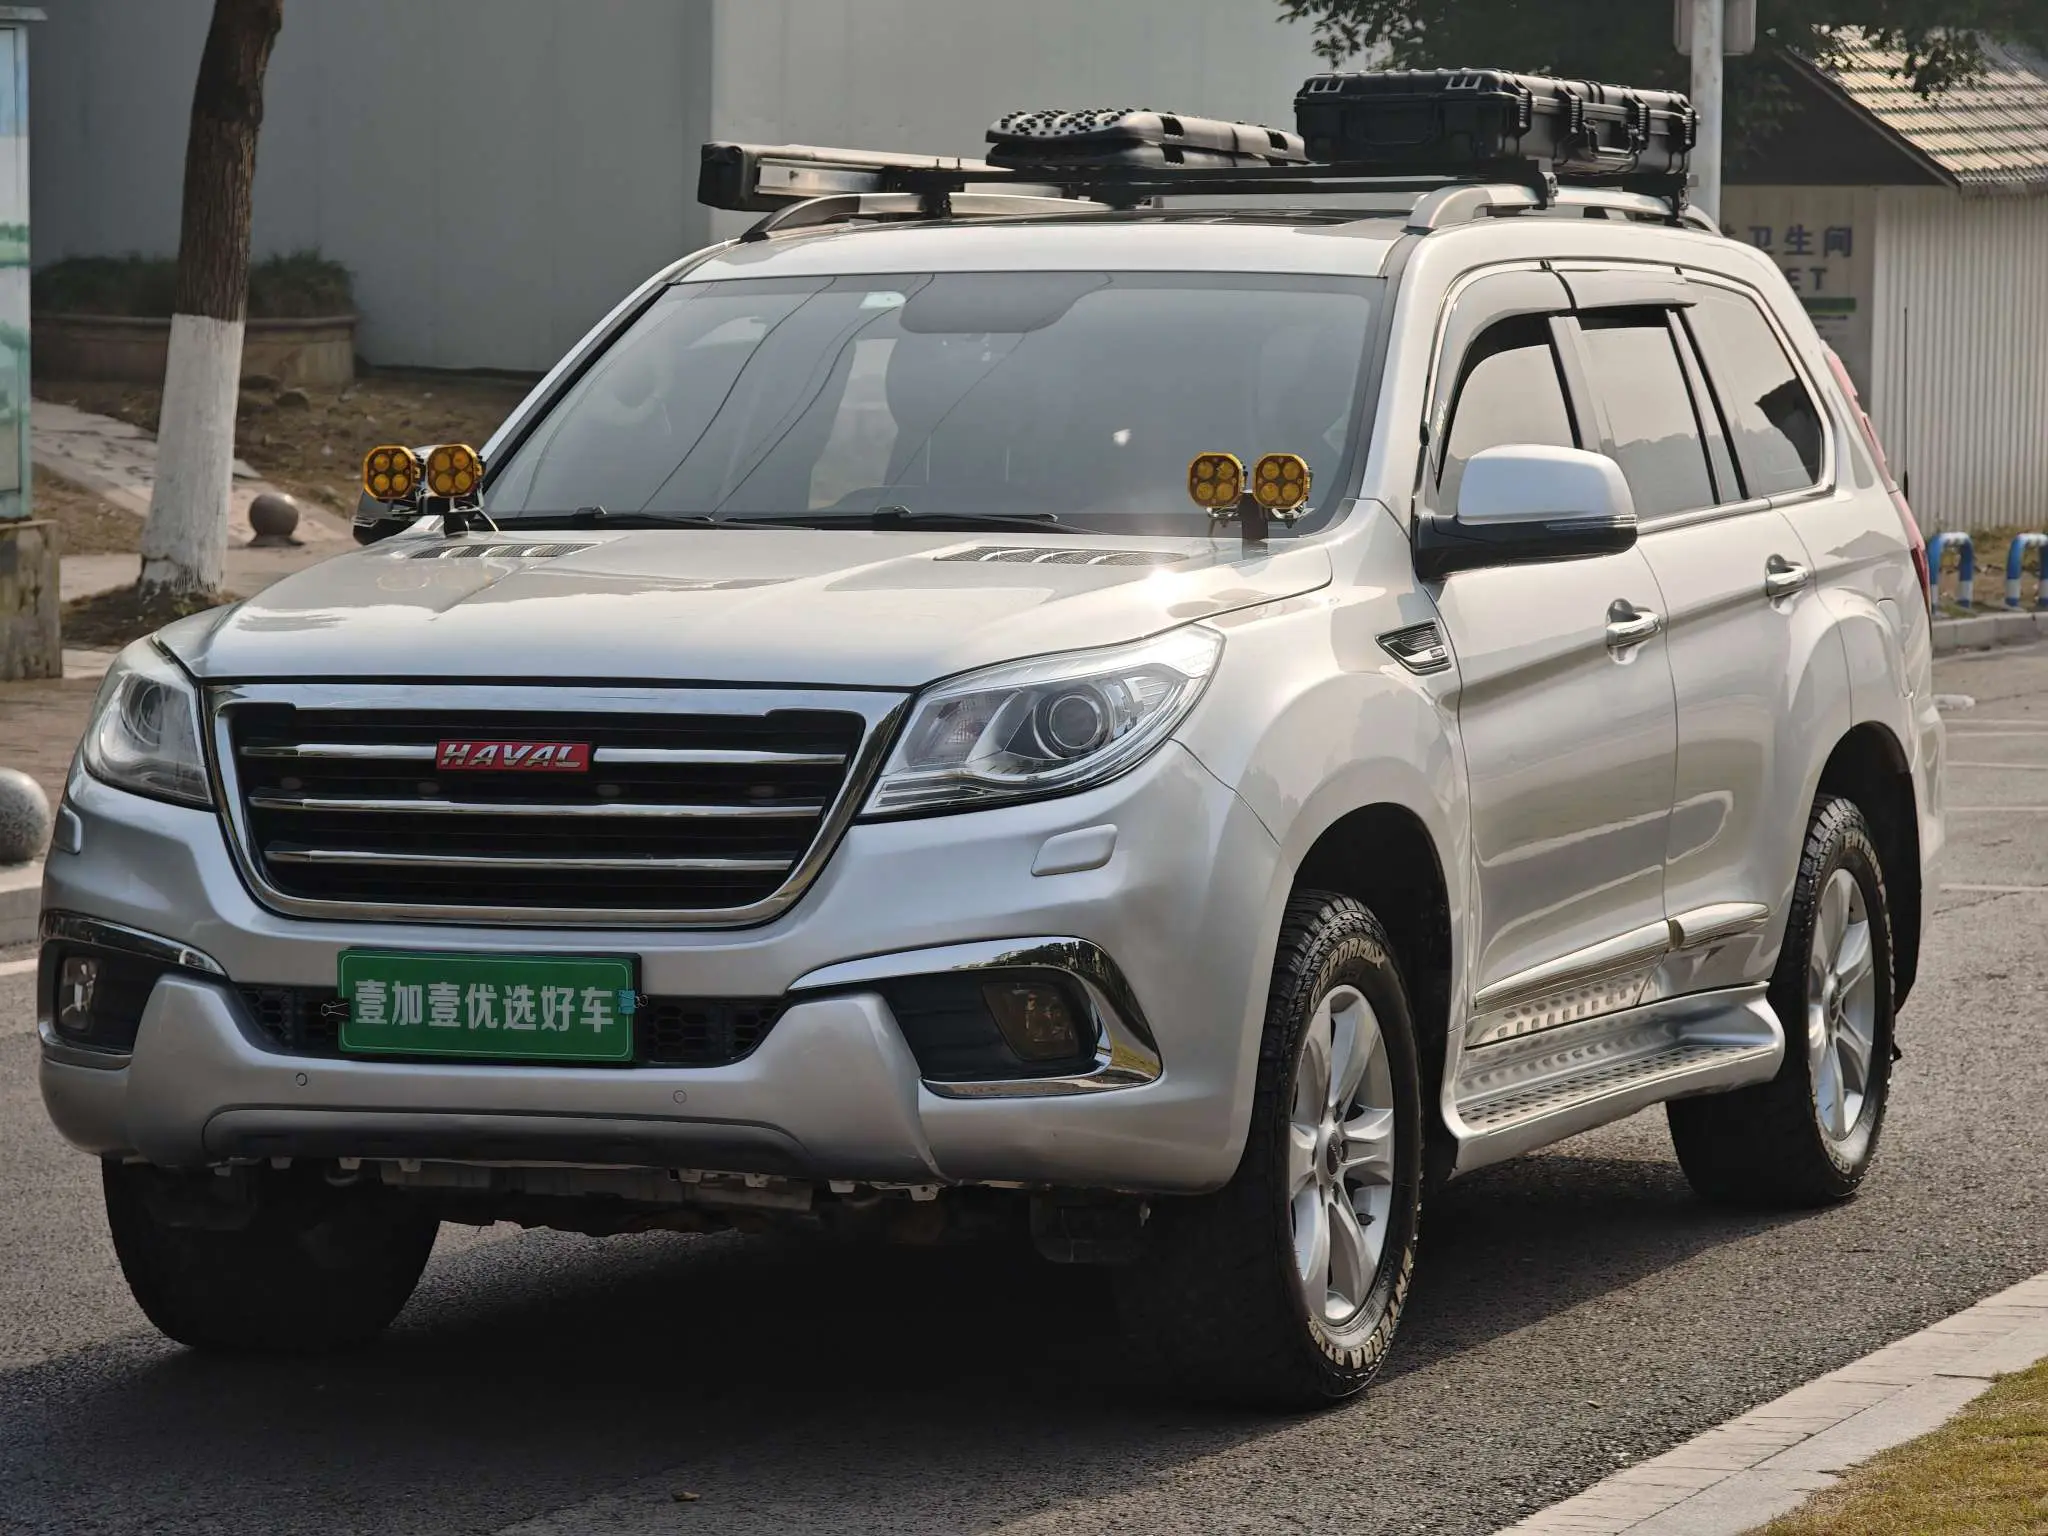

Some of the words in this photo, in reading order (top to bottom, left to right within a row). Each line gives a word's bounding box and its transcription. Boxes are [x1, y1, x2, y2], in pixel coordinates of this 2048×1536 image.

[1721, 223, 1853, 258] 卫生间
[440, 743, 581, 768] HAVAL
[354, 979, 614, 1033] 壹加壹优选好车
